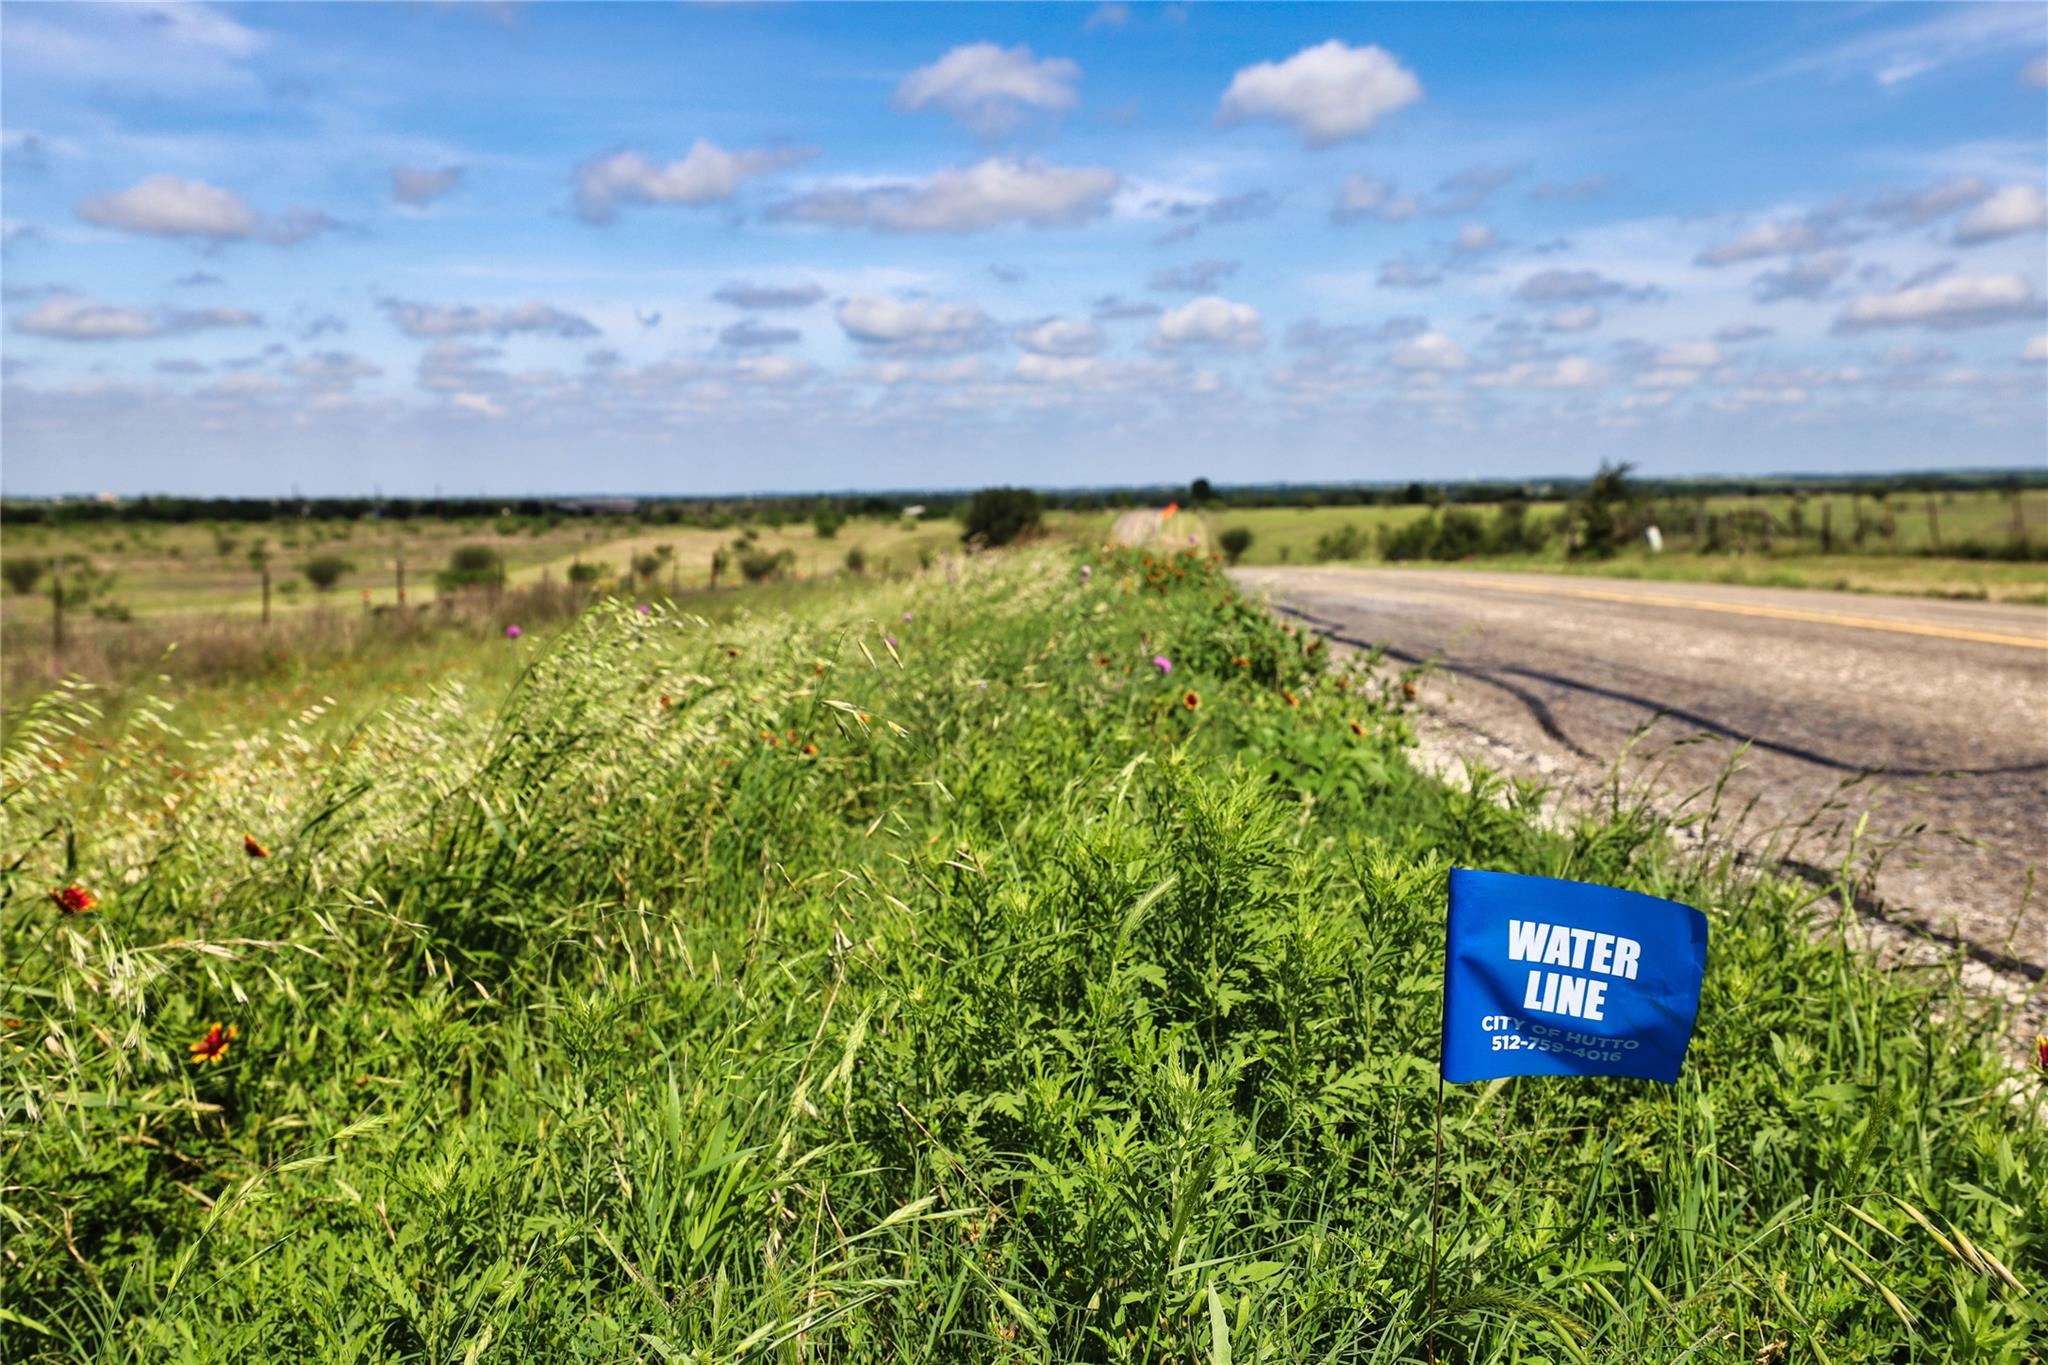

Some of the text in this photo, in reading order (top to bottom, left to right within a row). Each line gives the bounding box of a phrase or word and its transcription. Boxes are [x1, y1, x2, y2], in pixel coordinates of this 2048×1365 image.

[1508, 919, 1641, 980] WATER
[1523, 970, 1608, 1021] LINE
[1481, 1015, 1640, 1050] CITY OF HUTTO
[1491, 1035, 1622, 1062] 512-759-4016
